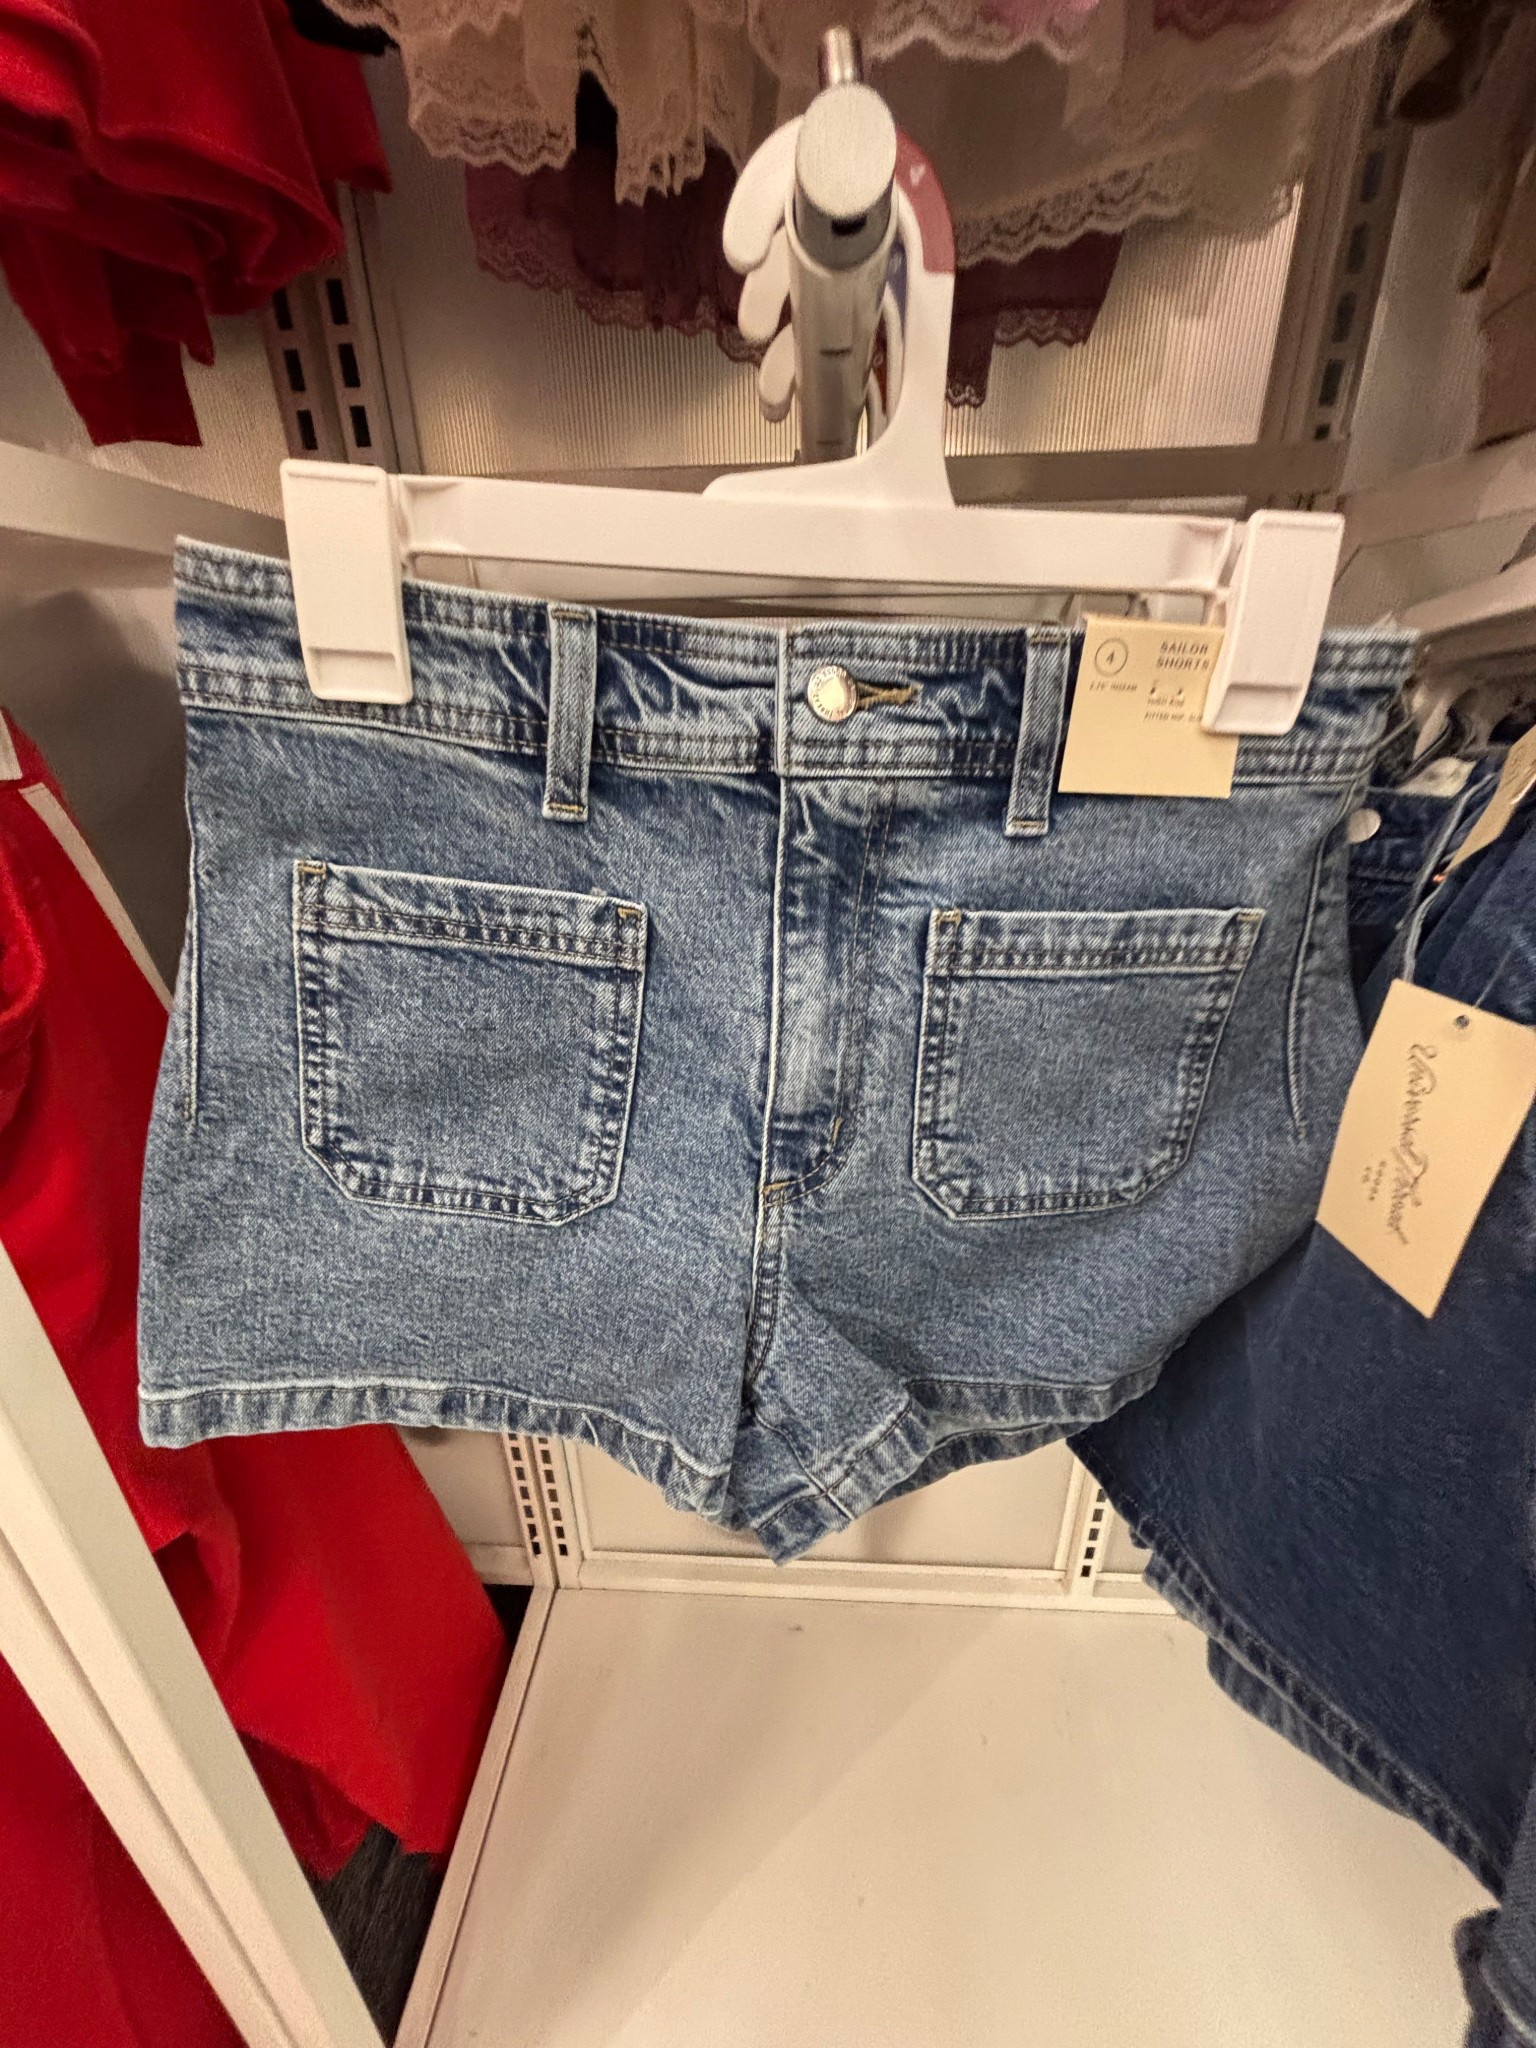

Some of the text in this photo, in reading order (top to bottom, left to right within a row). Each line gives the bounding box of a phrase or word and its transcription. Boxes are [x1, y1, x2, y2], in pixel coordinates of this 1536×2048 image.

[1160, 641, 1208, 655] SAILOR
[1106, 650, 1115, 664] 4
[1157, 657, 1209, 670] SHORTS
[1387, 1043, 1438, 1245] Universal Thread
